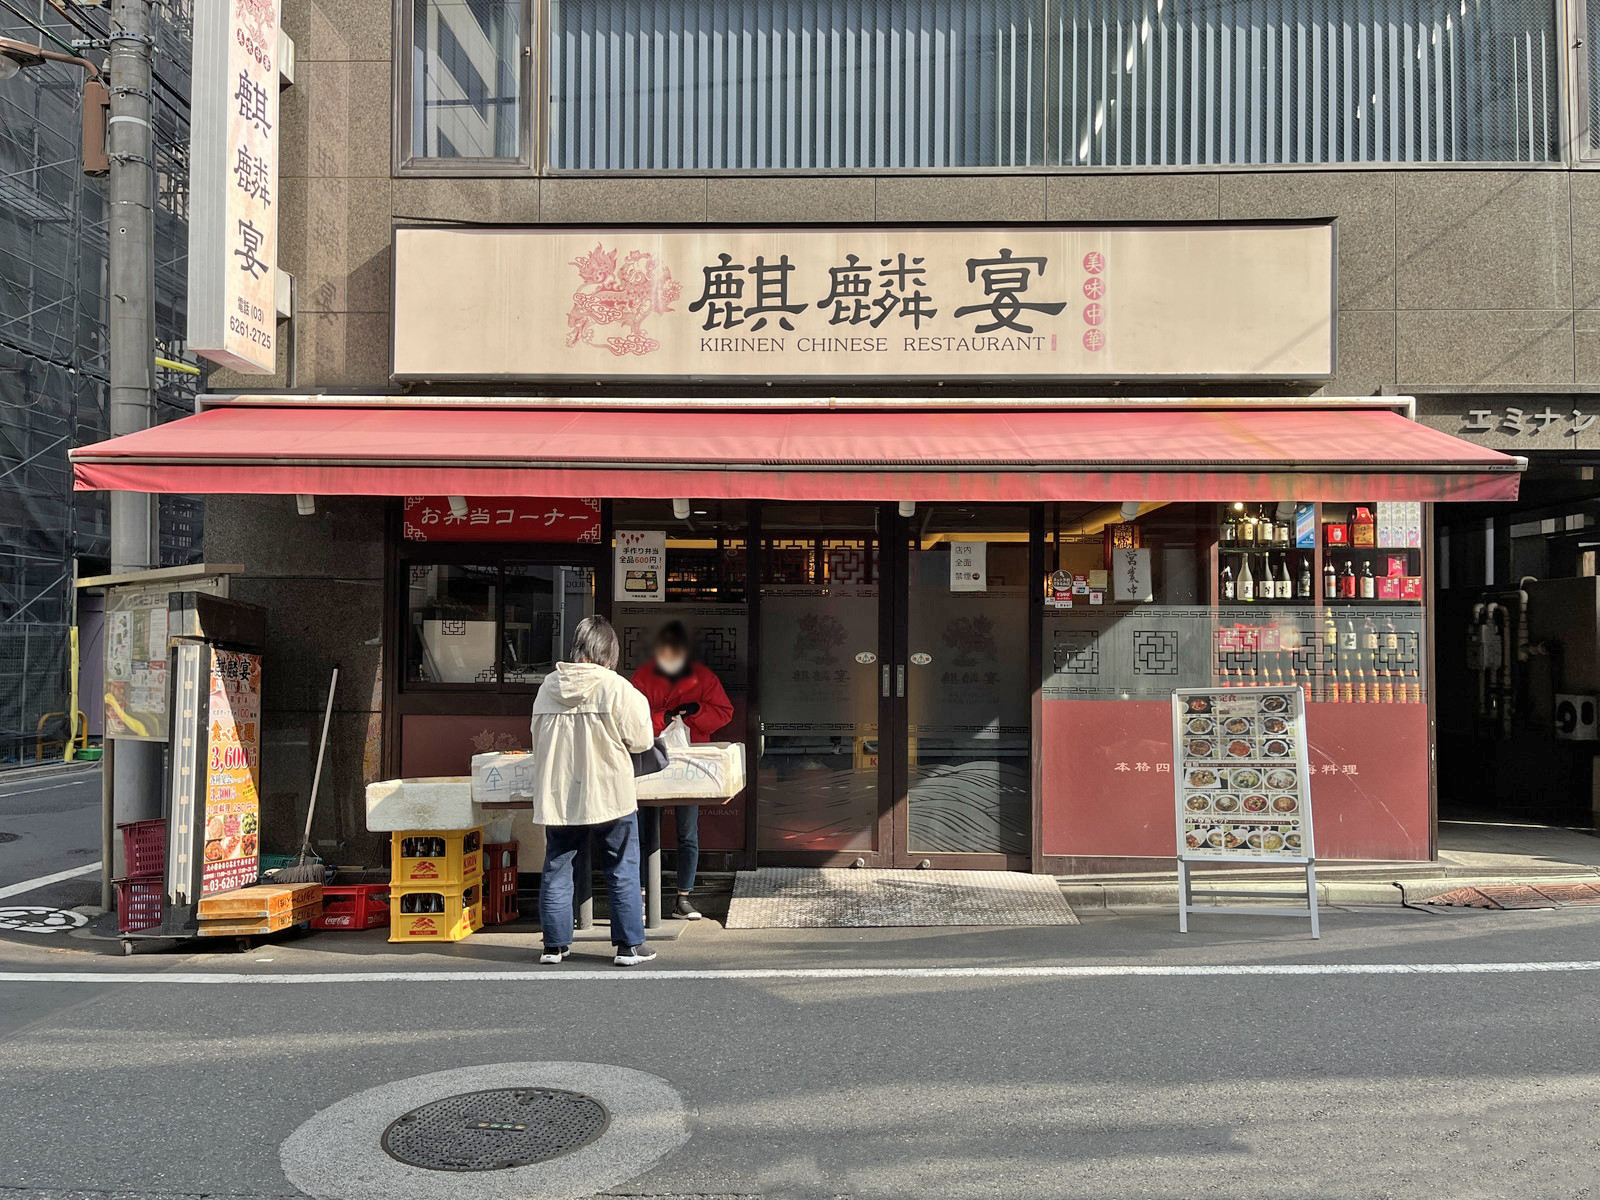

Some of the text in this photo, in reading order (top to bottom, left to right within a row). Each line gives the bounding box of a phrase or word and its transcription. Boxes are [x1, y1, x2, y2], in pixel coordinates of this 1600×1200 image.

[234, 69, 272, 280] 麒麟宴
[688, 248, 1067, 333] 麒麟宴
[1083, 251, 1106, 352] 美味中華
[251, 305, 265, 325] (03)
[230, 316, 271, 349] 6261-2725
[700, 337, 785, 352] KIRINEN
[797, 337, 888, 352] CHINESE
[904, 336, 1046, 351] RESTAURANT
[1466, 407, 1596, 432] エミナン
[623, 547, 659, 555] 手作り弁当
[955, 546, 972, 555] 店内
[955, 559, 972, 567] 全面
[211, 720, 255, 742] 食べ放題
[210, 871, 257, 892] 03-6261-2725
